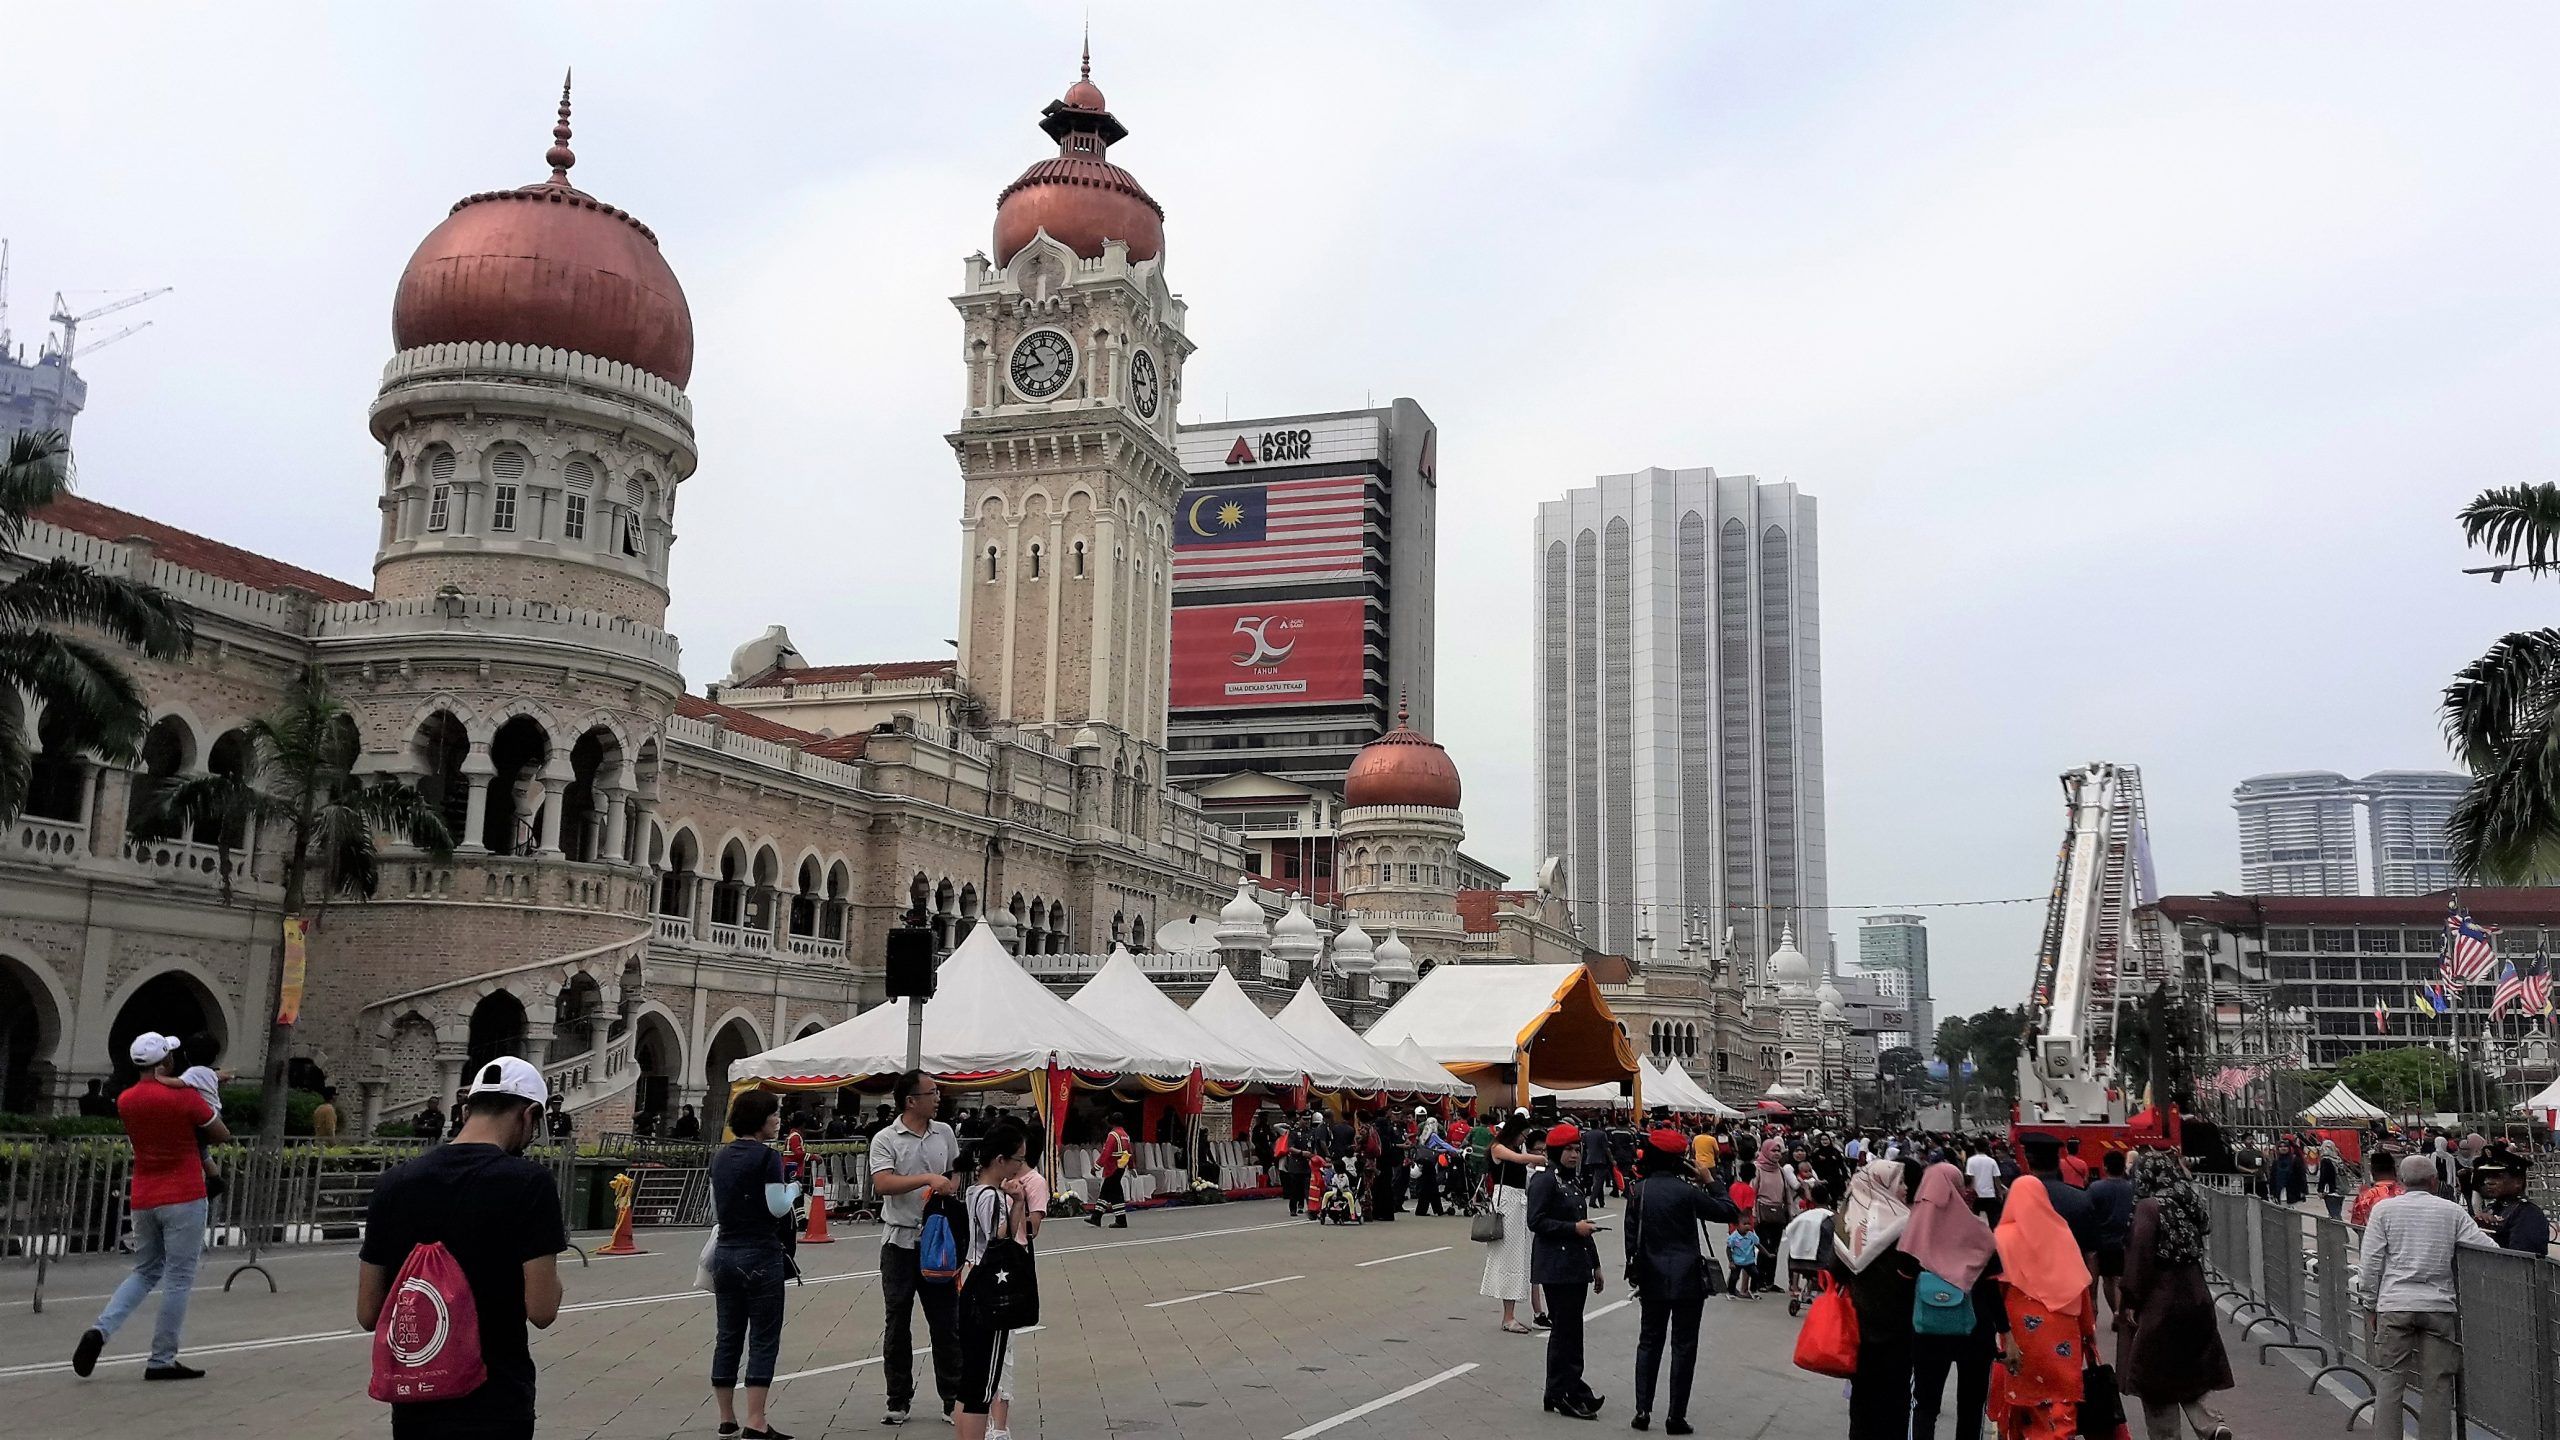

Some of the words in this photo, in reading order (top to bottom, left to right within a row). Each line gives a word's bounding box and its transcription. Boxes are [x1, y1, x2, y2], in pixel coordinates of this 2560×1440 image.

[1262, 429, 1311, 446] AGRO
[1263, 443, 1311, 461] BANK
[1254, 667, 1278, 675] TAHUN
